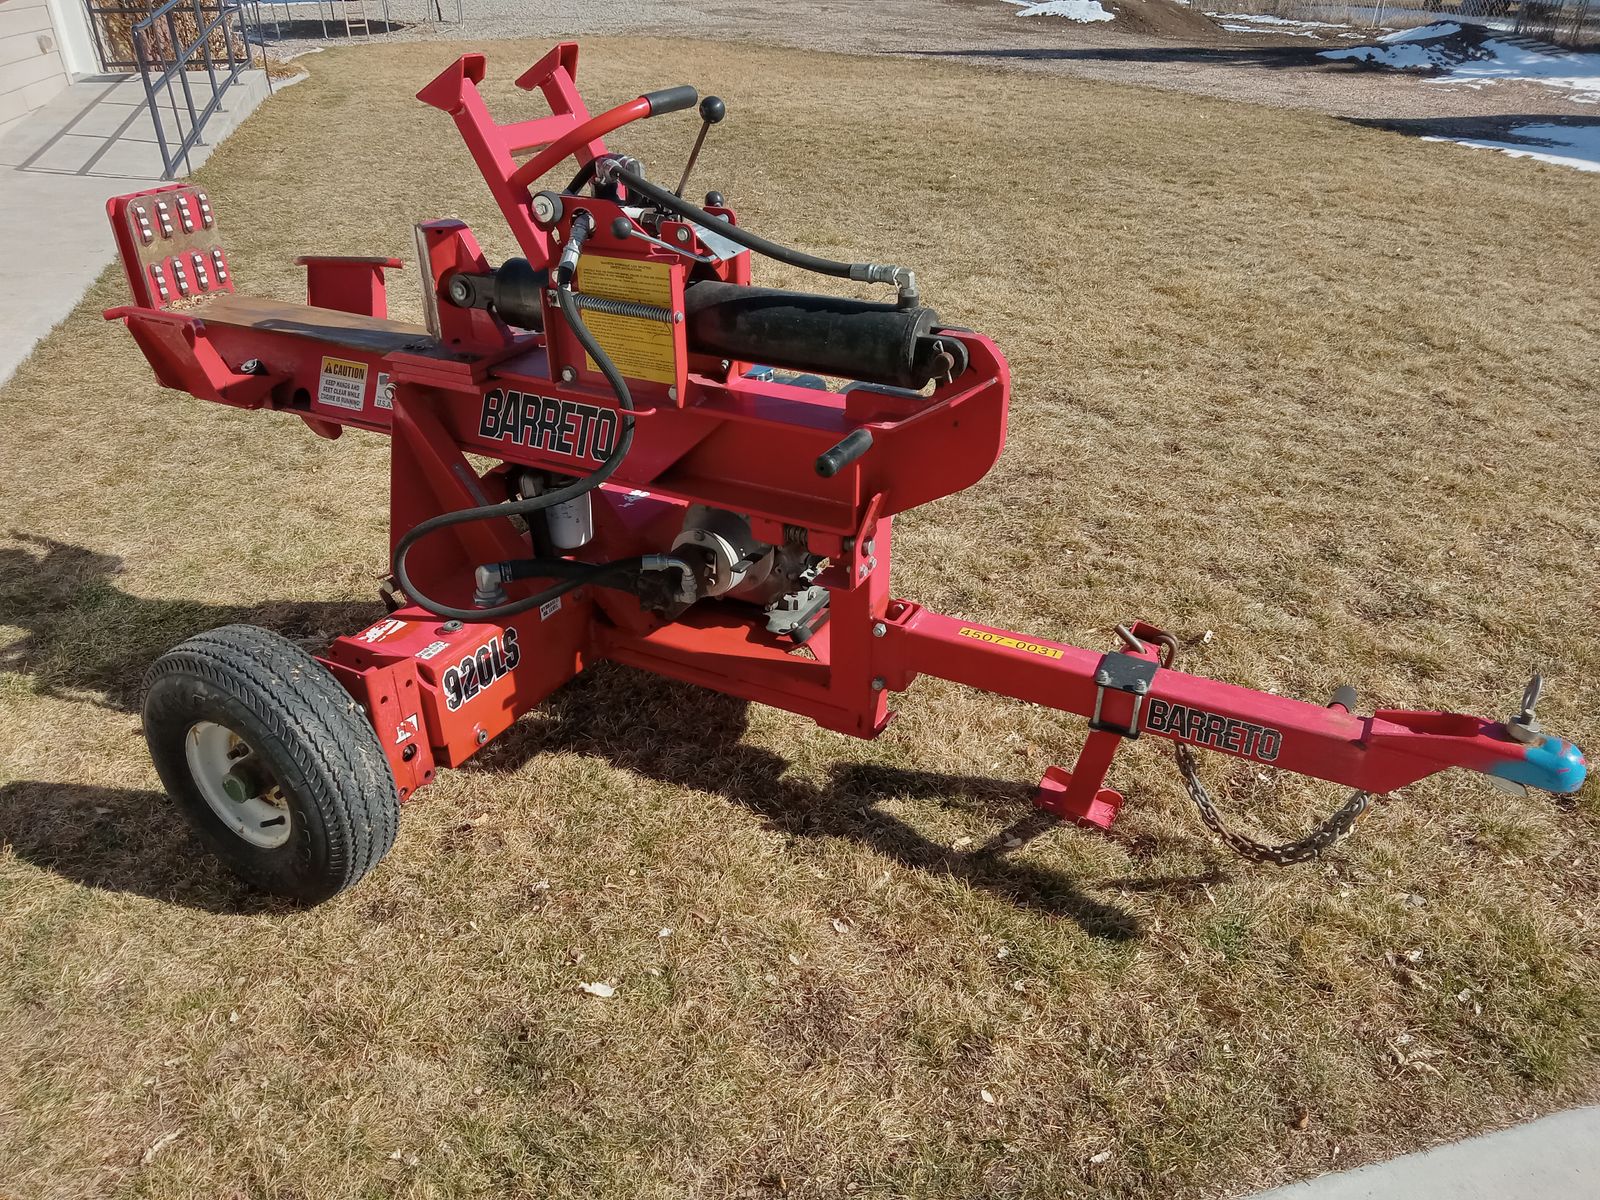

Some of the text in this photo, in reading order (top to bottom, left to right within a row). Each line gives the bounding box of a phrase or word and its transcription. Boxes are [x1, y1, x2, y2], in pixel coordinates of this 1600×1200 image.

[333, 364, 364, 380] CAUTION
[333, 388, 347, 396] CLEAR
[347, 390, 361, 399] WHILE
[478, 388, 618, 463] BARRETO
[960, 629, 1059, 657] 4507-0031
[442, 626, 521, 712] 920LS
[1146, 698, 1283, 761] BARRETO
